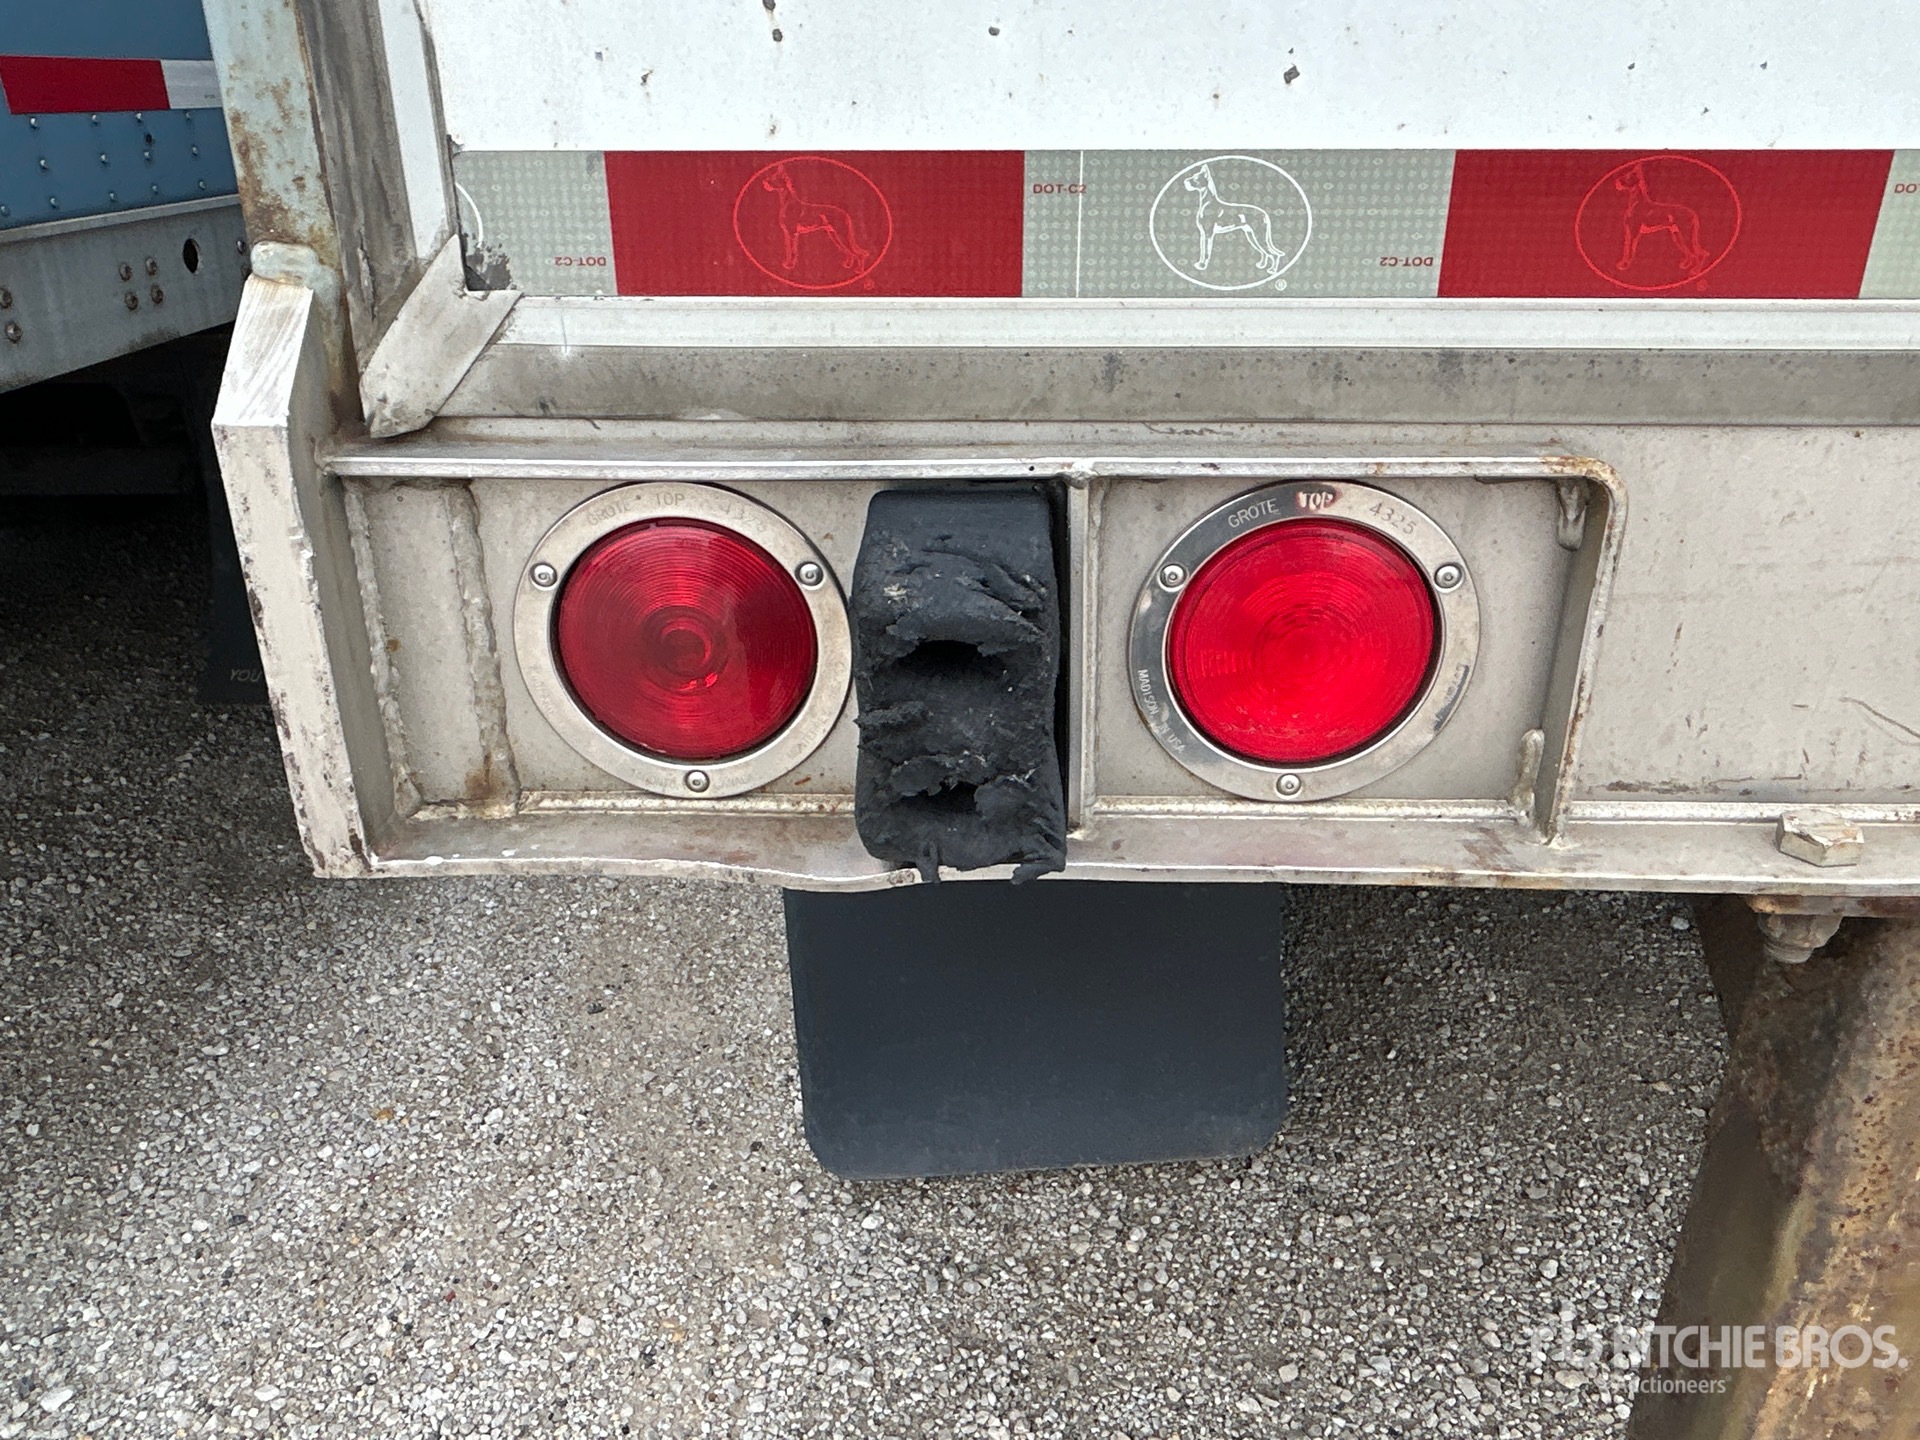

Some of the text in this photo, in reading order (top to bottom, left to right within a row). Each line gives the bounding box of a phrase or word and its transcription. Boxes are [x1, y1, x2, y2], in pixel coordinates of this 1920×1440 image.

[1033, 184, 1087, 194] DOT-C2
[1894, 183, 1920, 194] DO
[554, 256, 607, 267] DOT-C2
[1379, 256, 1434, 267] DOT-C2
[655, 493, 685, 506] TOP
[1227, 491, 1417, 534] GROTE TOP 4325
